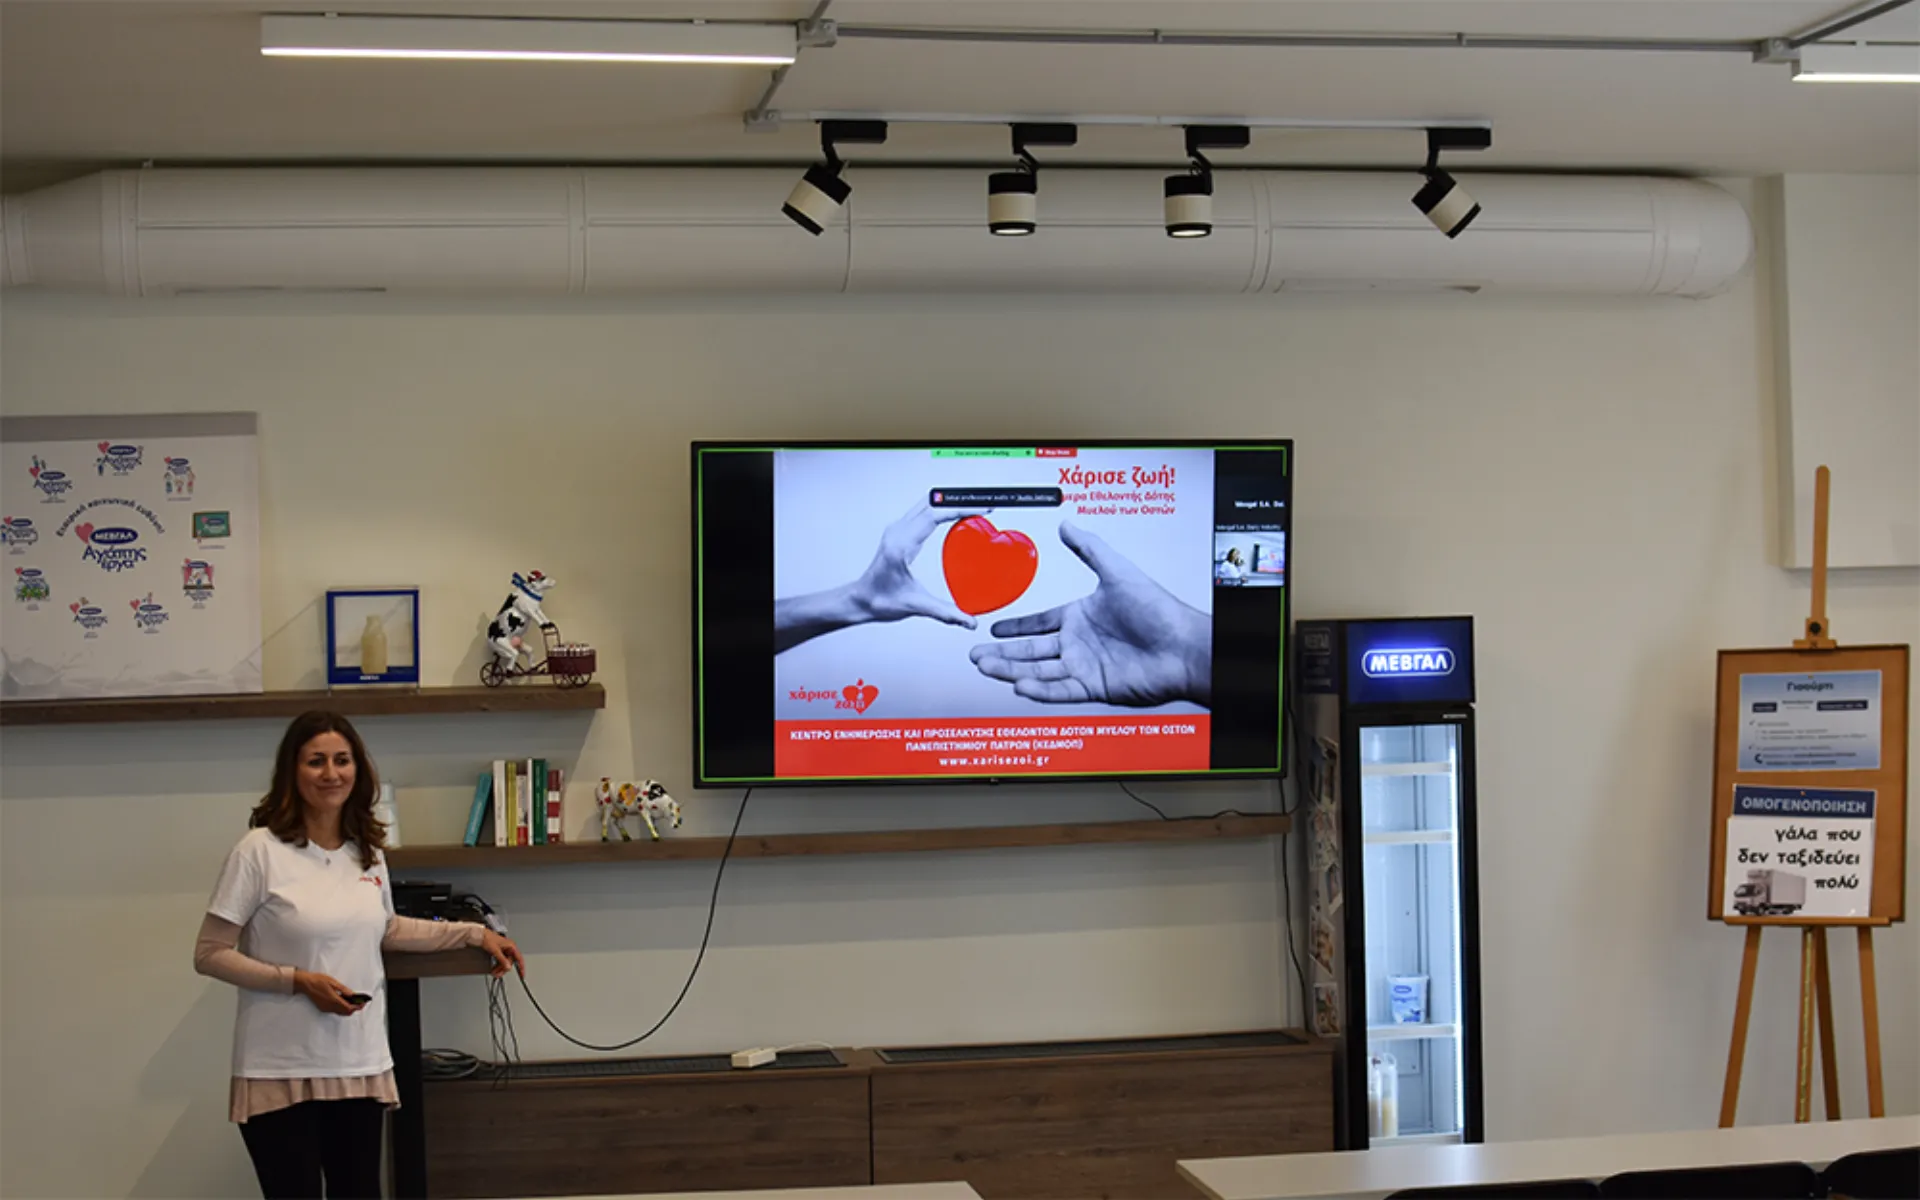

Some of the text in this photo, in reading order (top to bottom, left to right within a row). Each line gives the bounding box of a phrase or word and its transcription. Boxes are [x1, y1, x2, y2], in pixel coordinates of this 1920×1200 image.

[1058, 464, 1175, 489] Χάρισε ζωή!
[1062, 490, 1176, 503] μερα Εθελοντής Δότης
[1077, 504, 1175, 515] Μυελού των Οστών
[82, 544, 147, 564] Αγάπης
[101, 556, 134, 572] έργα
[1370, 653, 1448, 673] ΜΕΒΓΑΛ
[789, 685, 838, 703] χάρισε
[790, 729, 832, 740] ΚΕΝΤΡΟ
[904, 728, 921, 738] ΚΑΙ
[1096, 725, 1137, 735] ΜΥΕΛΟΥ
[905, 741, 987, 751] ΠΑΝΕΠΙΣΤΗΜΙΟΥ
[939, 755, 1050, 767] www.xarisezoi.gr
[1741, 796, 1867, 814] ΟΜΟΓΕΝΟΠΟΙΗΣΗ
[1775, 825, 1862, 843] γάλα που
[1737, 848, 1860, 867] δεν ταξιδεύει
[1814, 875, 1859, 890] πολύ
